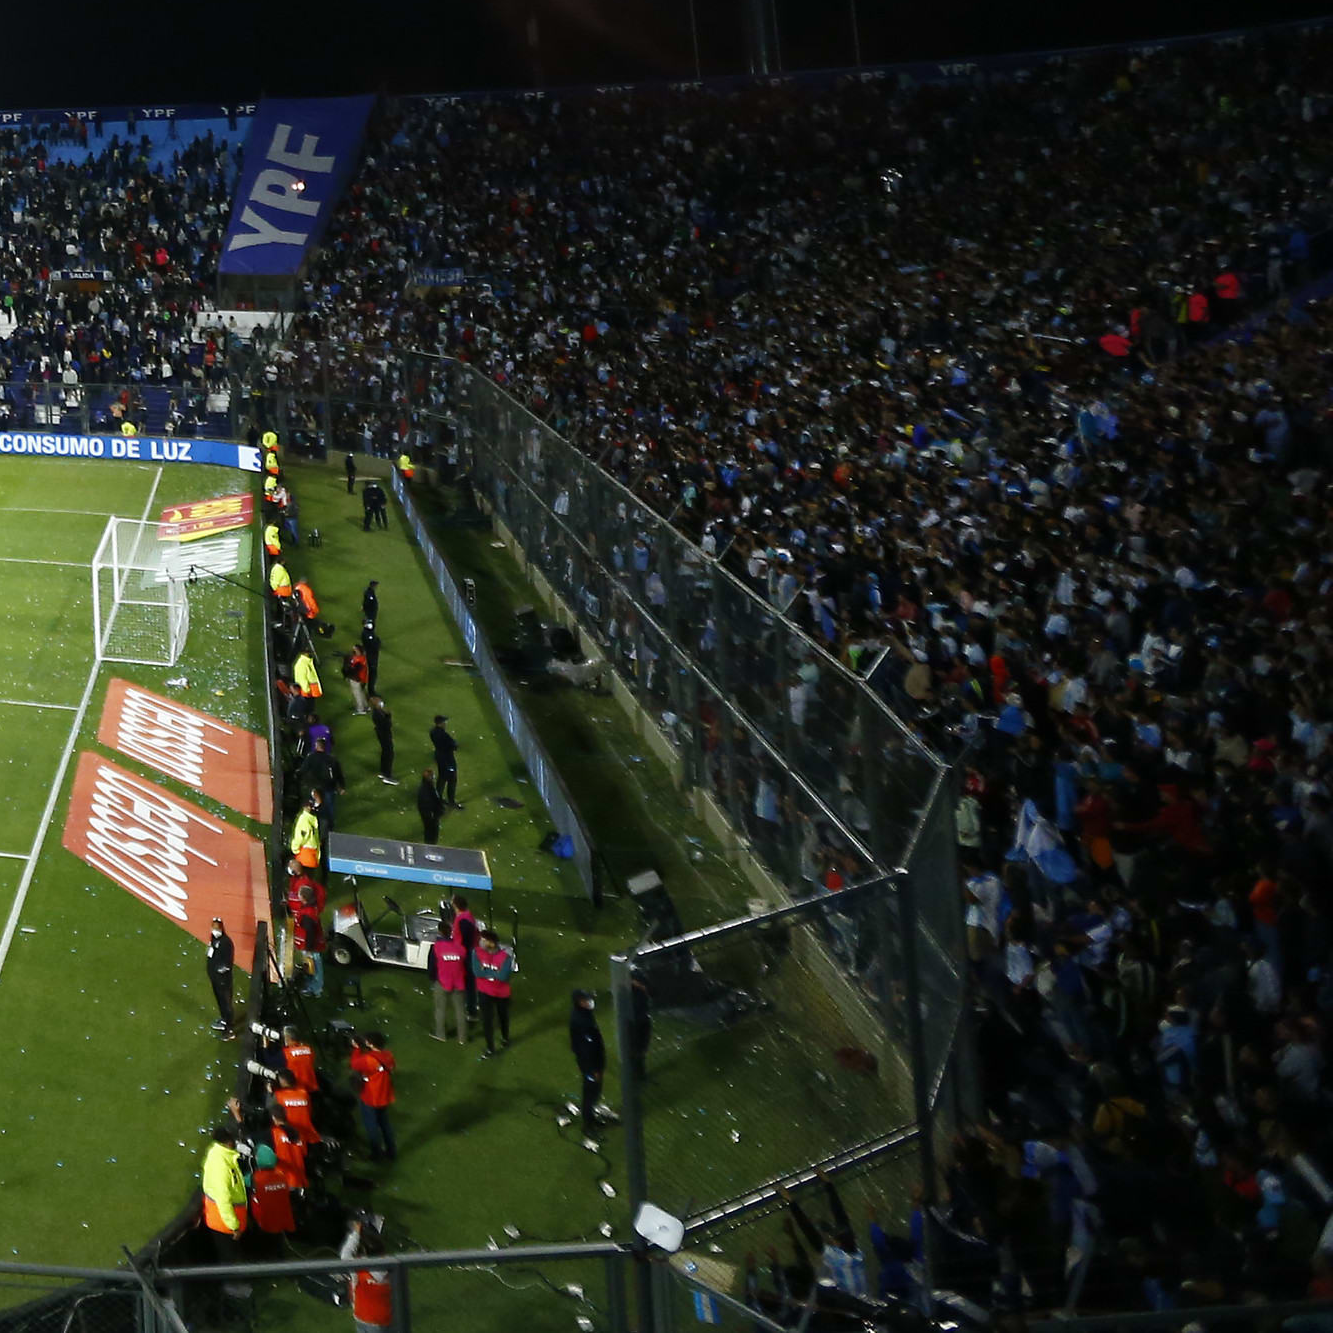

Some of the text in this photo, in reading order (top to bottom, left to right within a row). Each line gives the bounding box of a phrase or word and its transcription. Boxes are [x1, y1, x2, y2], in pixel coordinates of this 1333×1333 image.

[141, 108, 176, 118] YPF
[228, 122, 335, 253] YPF
[69, 271, 95, 280] SALIDA
[112, 439, 140, 459] DE
[151, 440, 192, 461] LUZ
[117, 688, 233, 787] betsson
[85, 765, 223, 921] betsson
